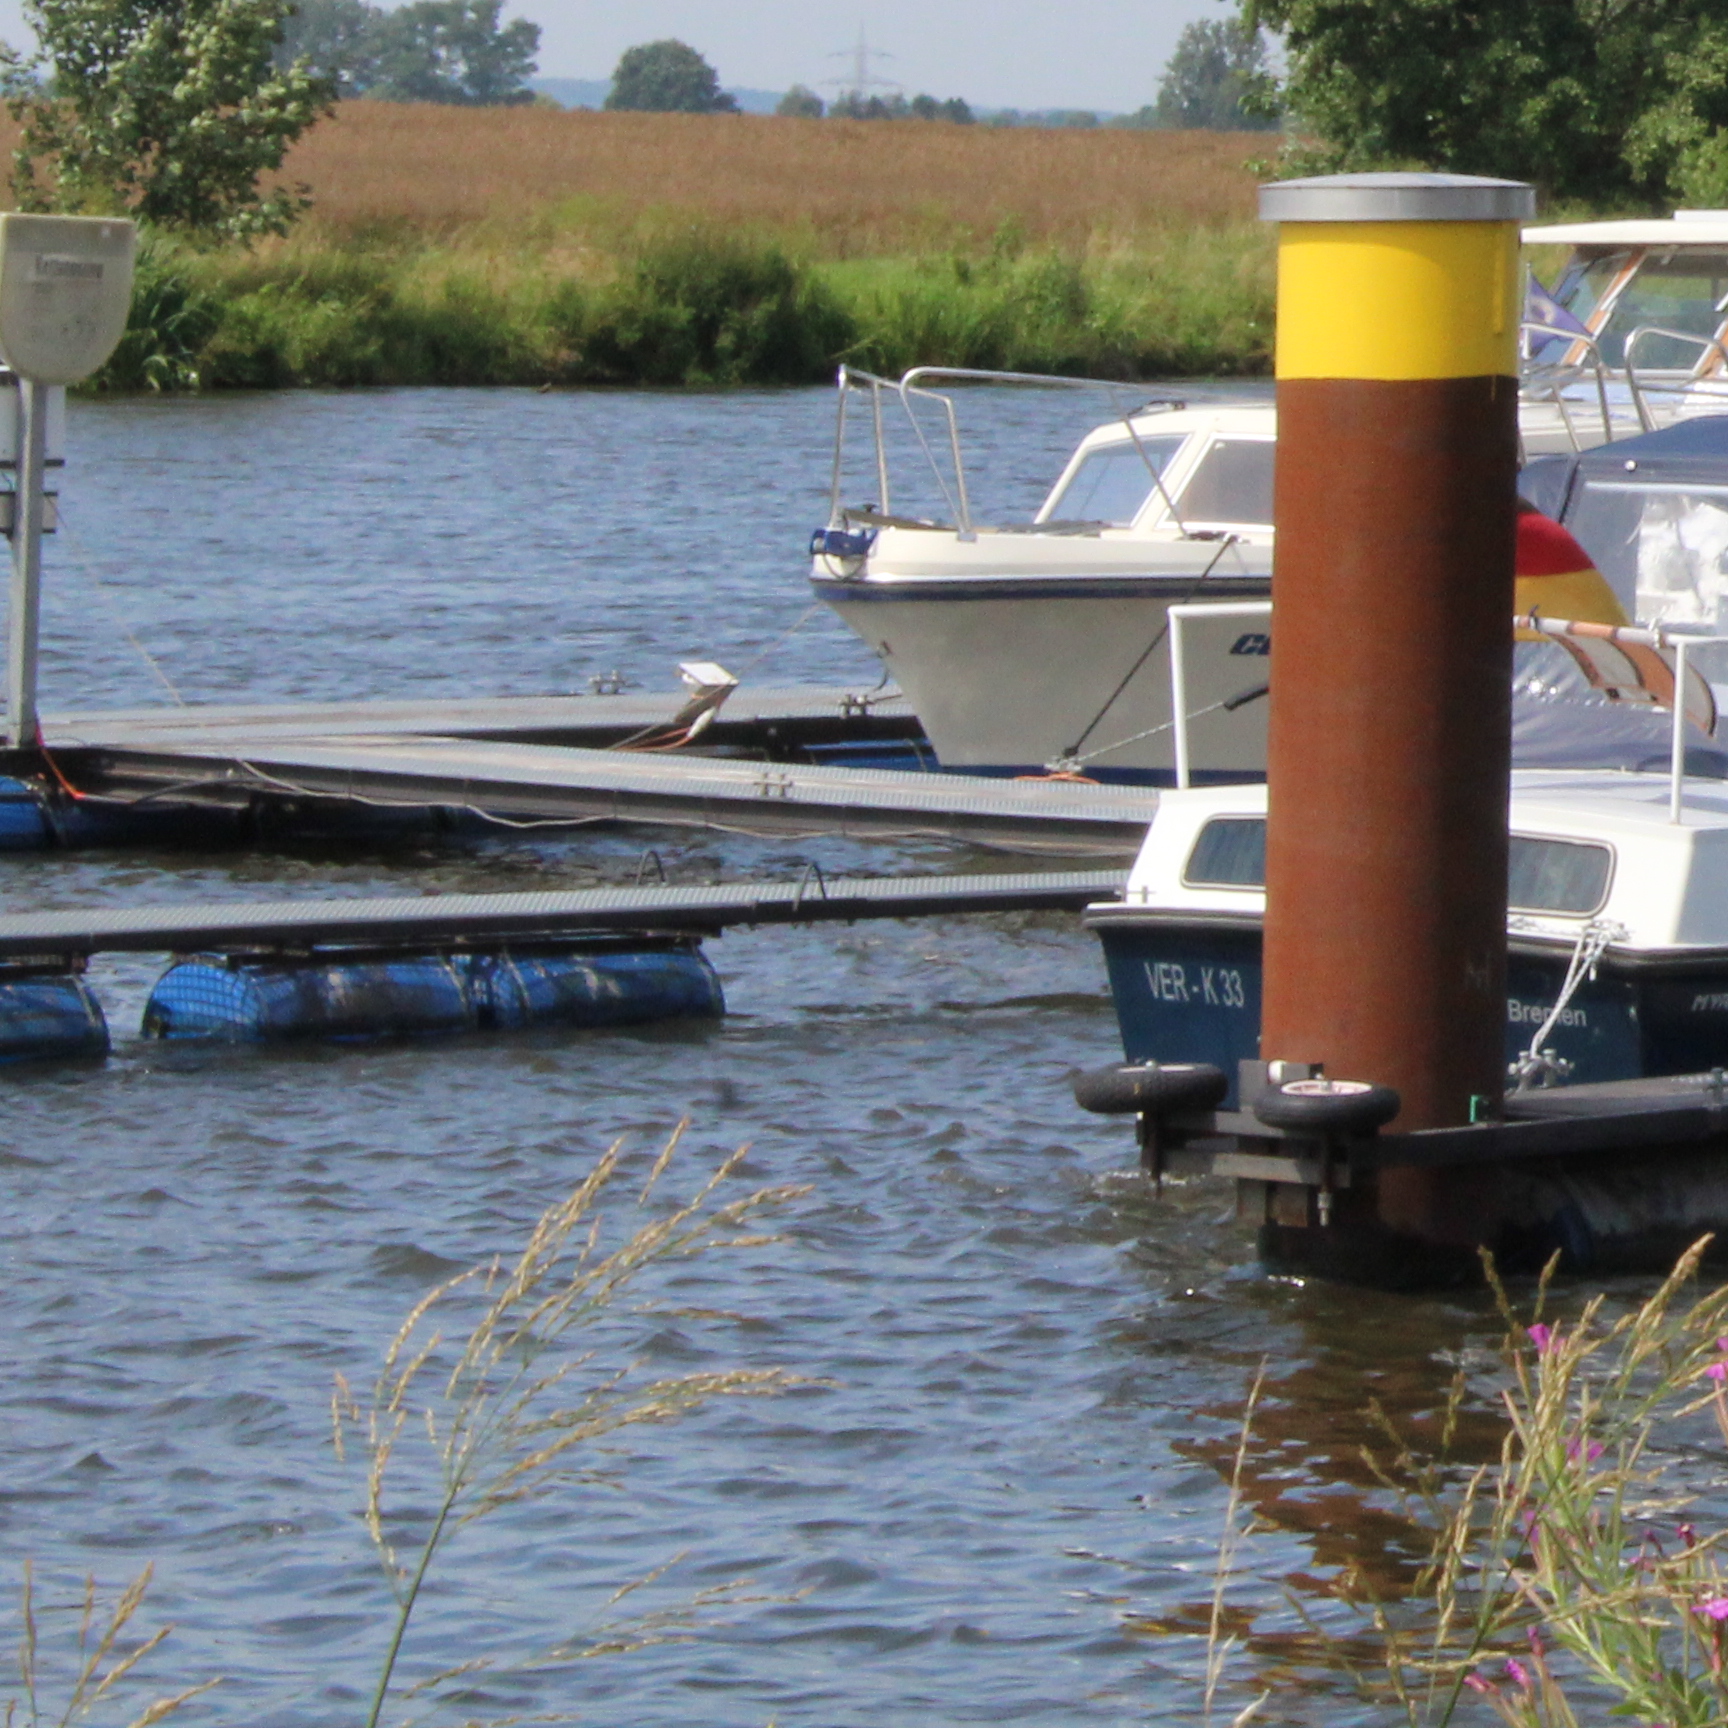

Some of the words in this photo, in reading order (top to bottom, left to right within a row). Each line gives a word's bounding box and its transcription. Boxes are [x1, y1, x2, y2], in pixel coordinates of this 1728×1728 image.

[1143, 961, 1190, 1002] VER
[1201, 966, 1219, 1006] K
[1219, 968, 1245, 1009] 33
